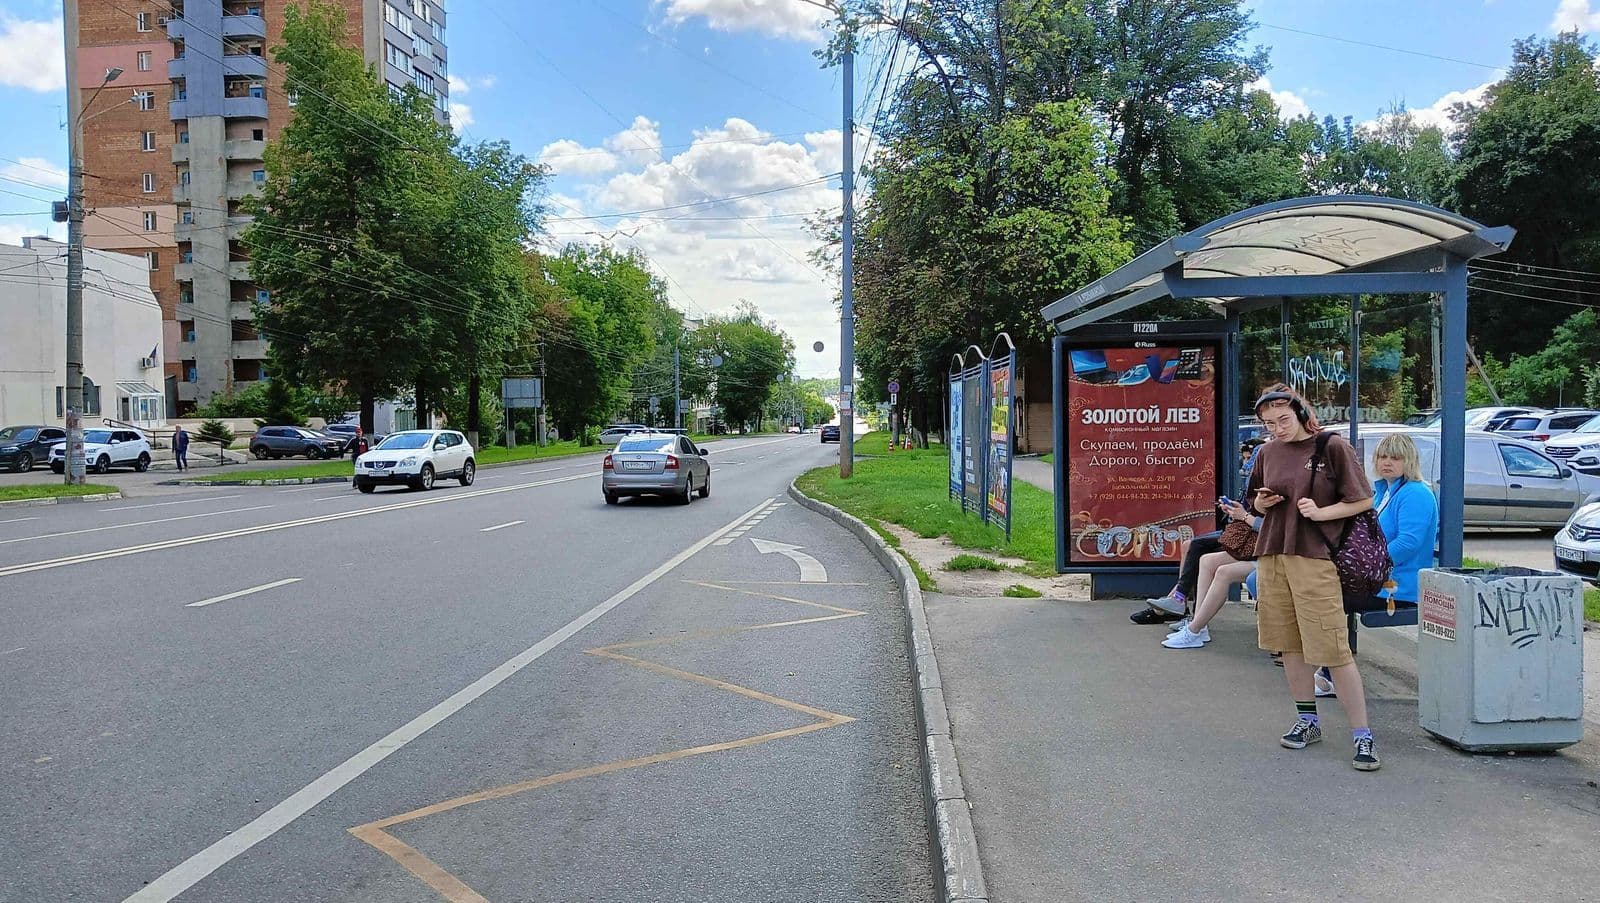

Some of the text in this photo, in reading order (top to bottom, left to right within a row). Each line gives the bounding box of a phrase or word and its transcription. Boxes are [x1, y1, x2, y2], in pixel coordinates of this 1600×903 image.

[1133, 323, 1158, 333] 01220A
[1081, 404, 1200, 424] ЗОЛОТОЙ ЛЕВ
[1080, 438, 1203, 452] Скупаем, продаём!
[1089, 454, 1195, 468] Дорого, быстро
[1423, 594, 1455, 610] ПОМОЩЬ
